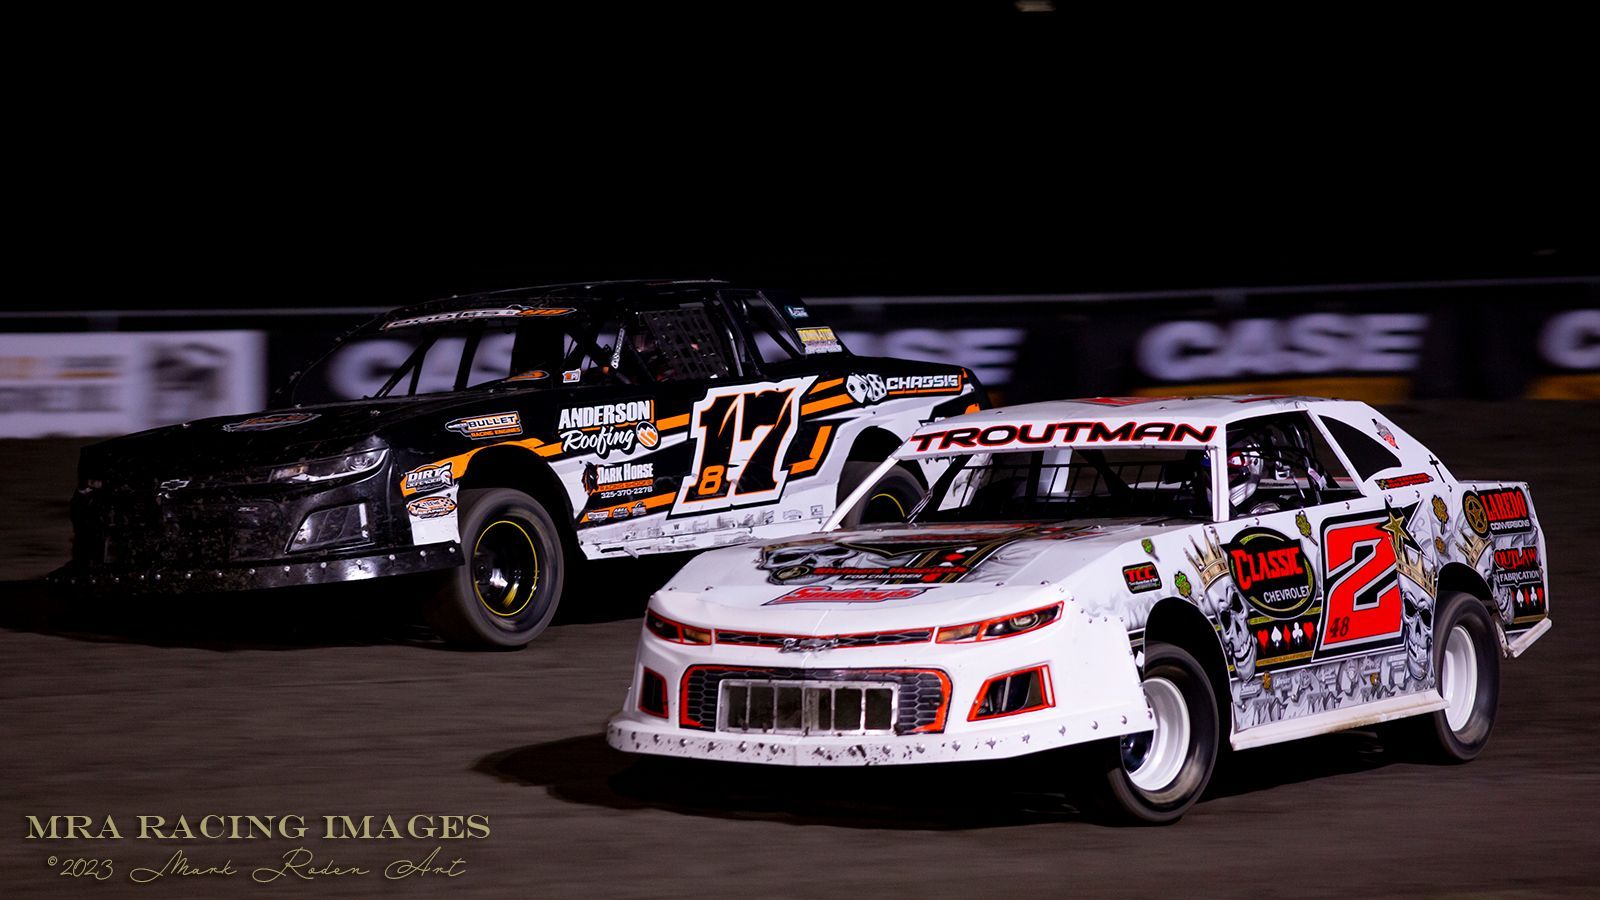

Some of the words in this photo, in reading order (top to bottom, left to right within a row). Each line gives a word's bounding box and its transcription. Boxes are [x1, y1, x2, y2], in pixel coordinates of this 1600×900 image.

[1135, 313, 1432, 381] CASE
[886, 374, 960, 391] CHASSIS
[467, 415, 516, 428] BULLET
[558, 400, 651, 431] ANDERSON
[560, 427, 635, 455] Roofing
[682, 385, 799, 503] 17
[910, 421, 1218, 452] TROUTMAN
[408, 467, 445, 481] DIRT
[598, 466, 623, 485] DARK
[623, 463, 654, 481] HORSE
[698, 465, 725, 496] 8
[1481, 490, 1527, 521] LAREDO
[1490, 520, 1530, 532] CONVERSIONS
[1230, 546, 1304, 590] CLASSIC
[1494, 545, 1538, 571] OUTLAW
[1126, 565, 1156, 583] TCC
[1324, 522, 1402, 647] 2
[1499, 571, 1540, 583] FABRICATION
[1263, 584, 1310, 604] CHEVROLET
[1329, 617, 1350, 638] 48
